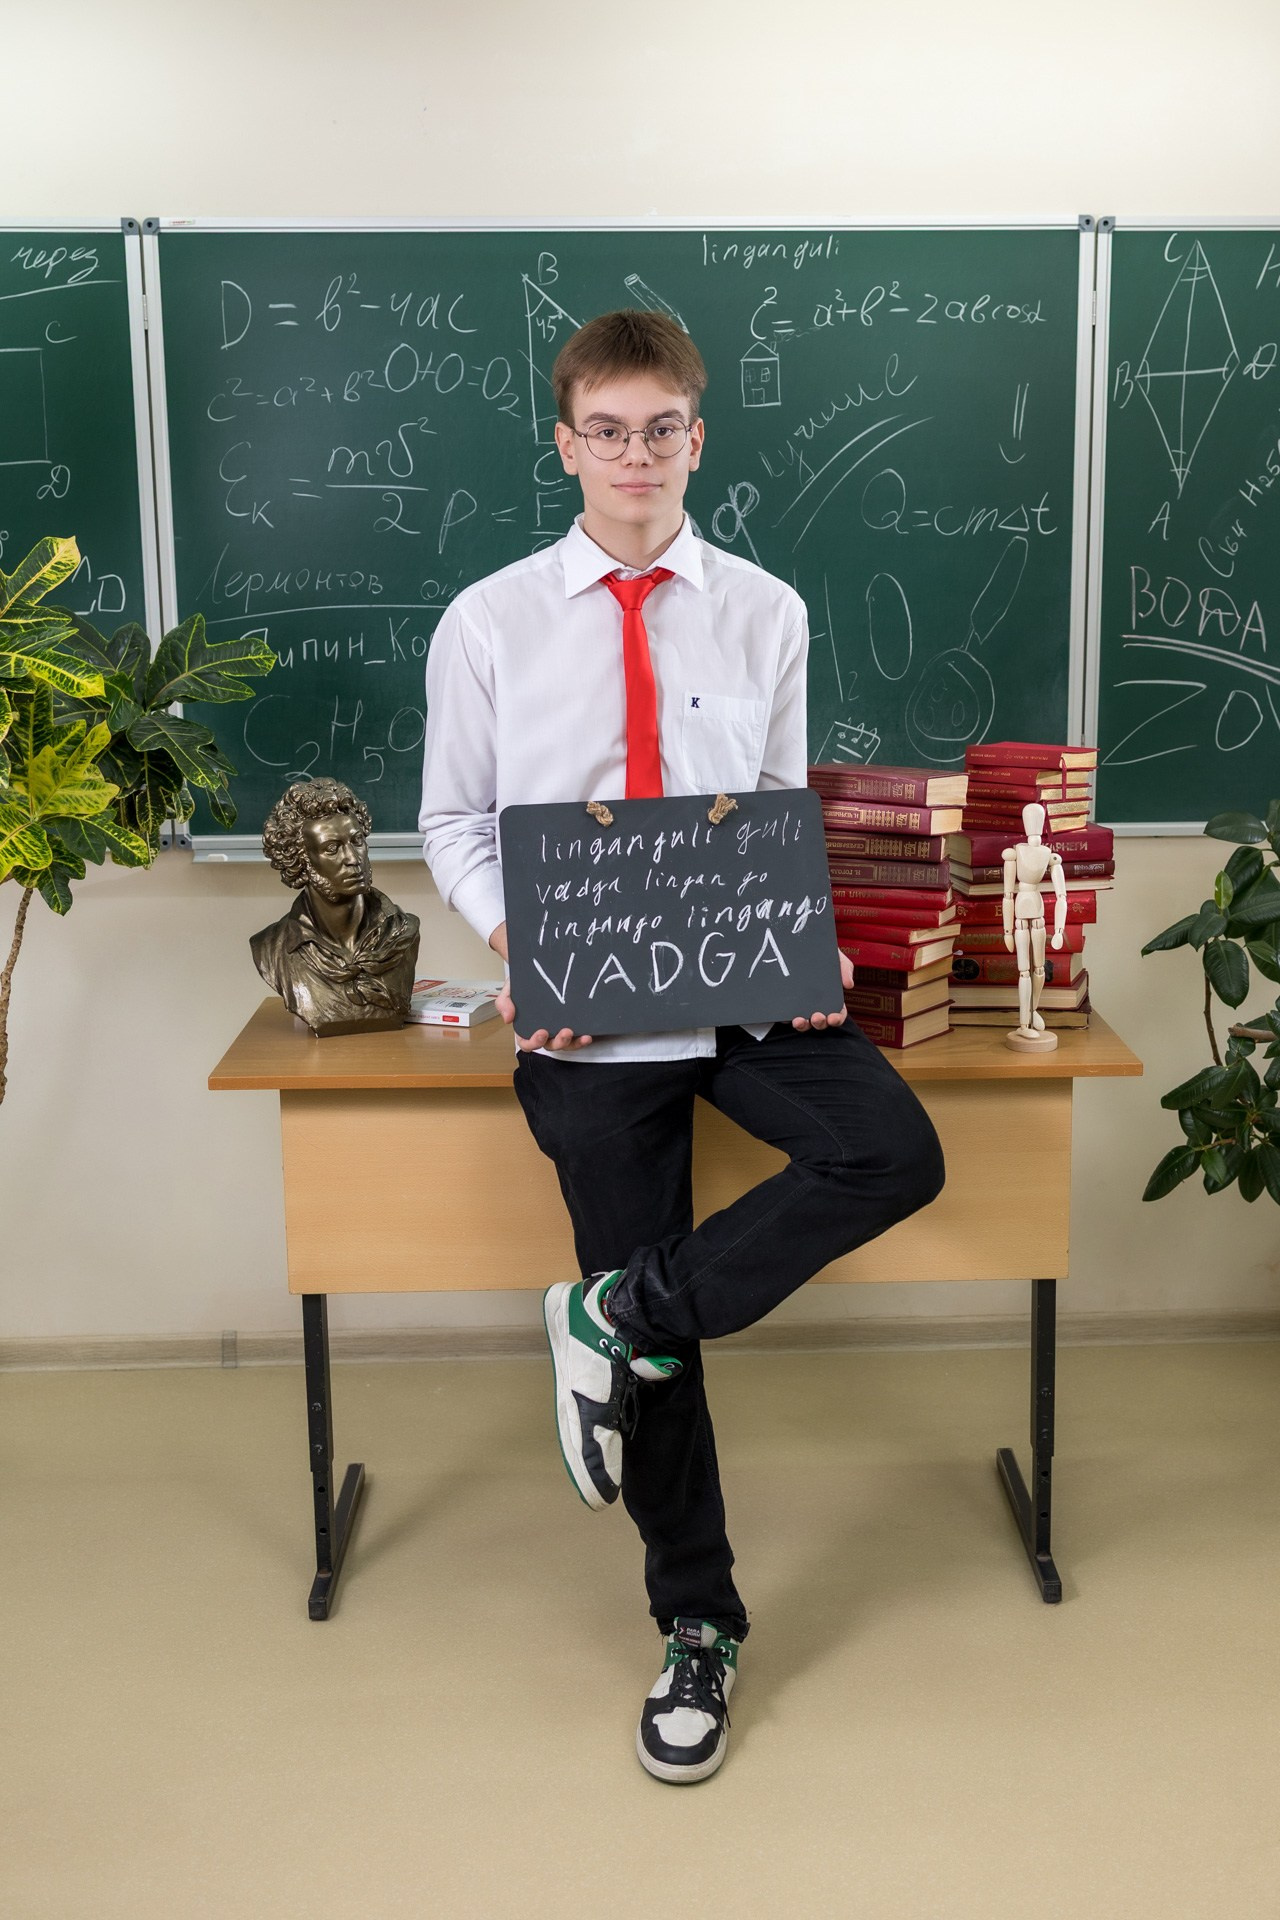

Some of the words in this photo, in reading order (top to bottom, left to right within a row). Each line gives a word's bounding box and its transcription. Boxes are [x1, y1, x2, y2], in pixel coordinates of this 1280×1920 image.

[10, 244, 100, 284] через
[702, 234, 839, 270] linganguli
[690, 696, 701, 709] K
[541, 820, 714, 864] linganguli
[735, 810, 803, 855] guli
[535, 876, 623, 905] vadga
[644, 868, 727, 899] lingan
[741, 870, 769, 897] go
[531, 927, 791, 1005] VADGA
